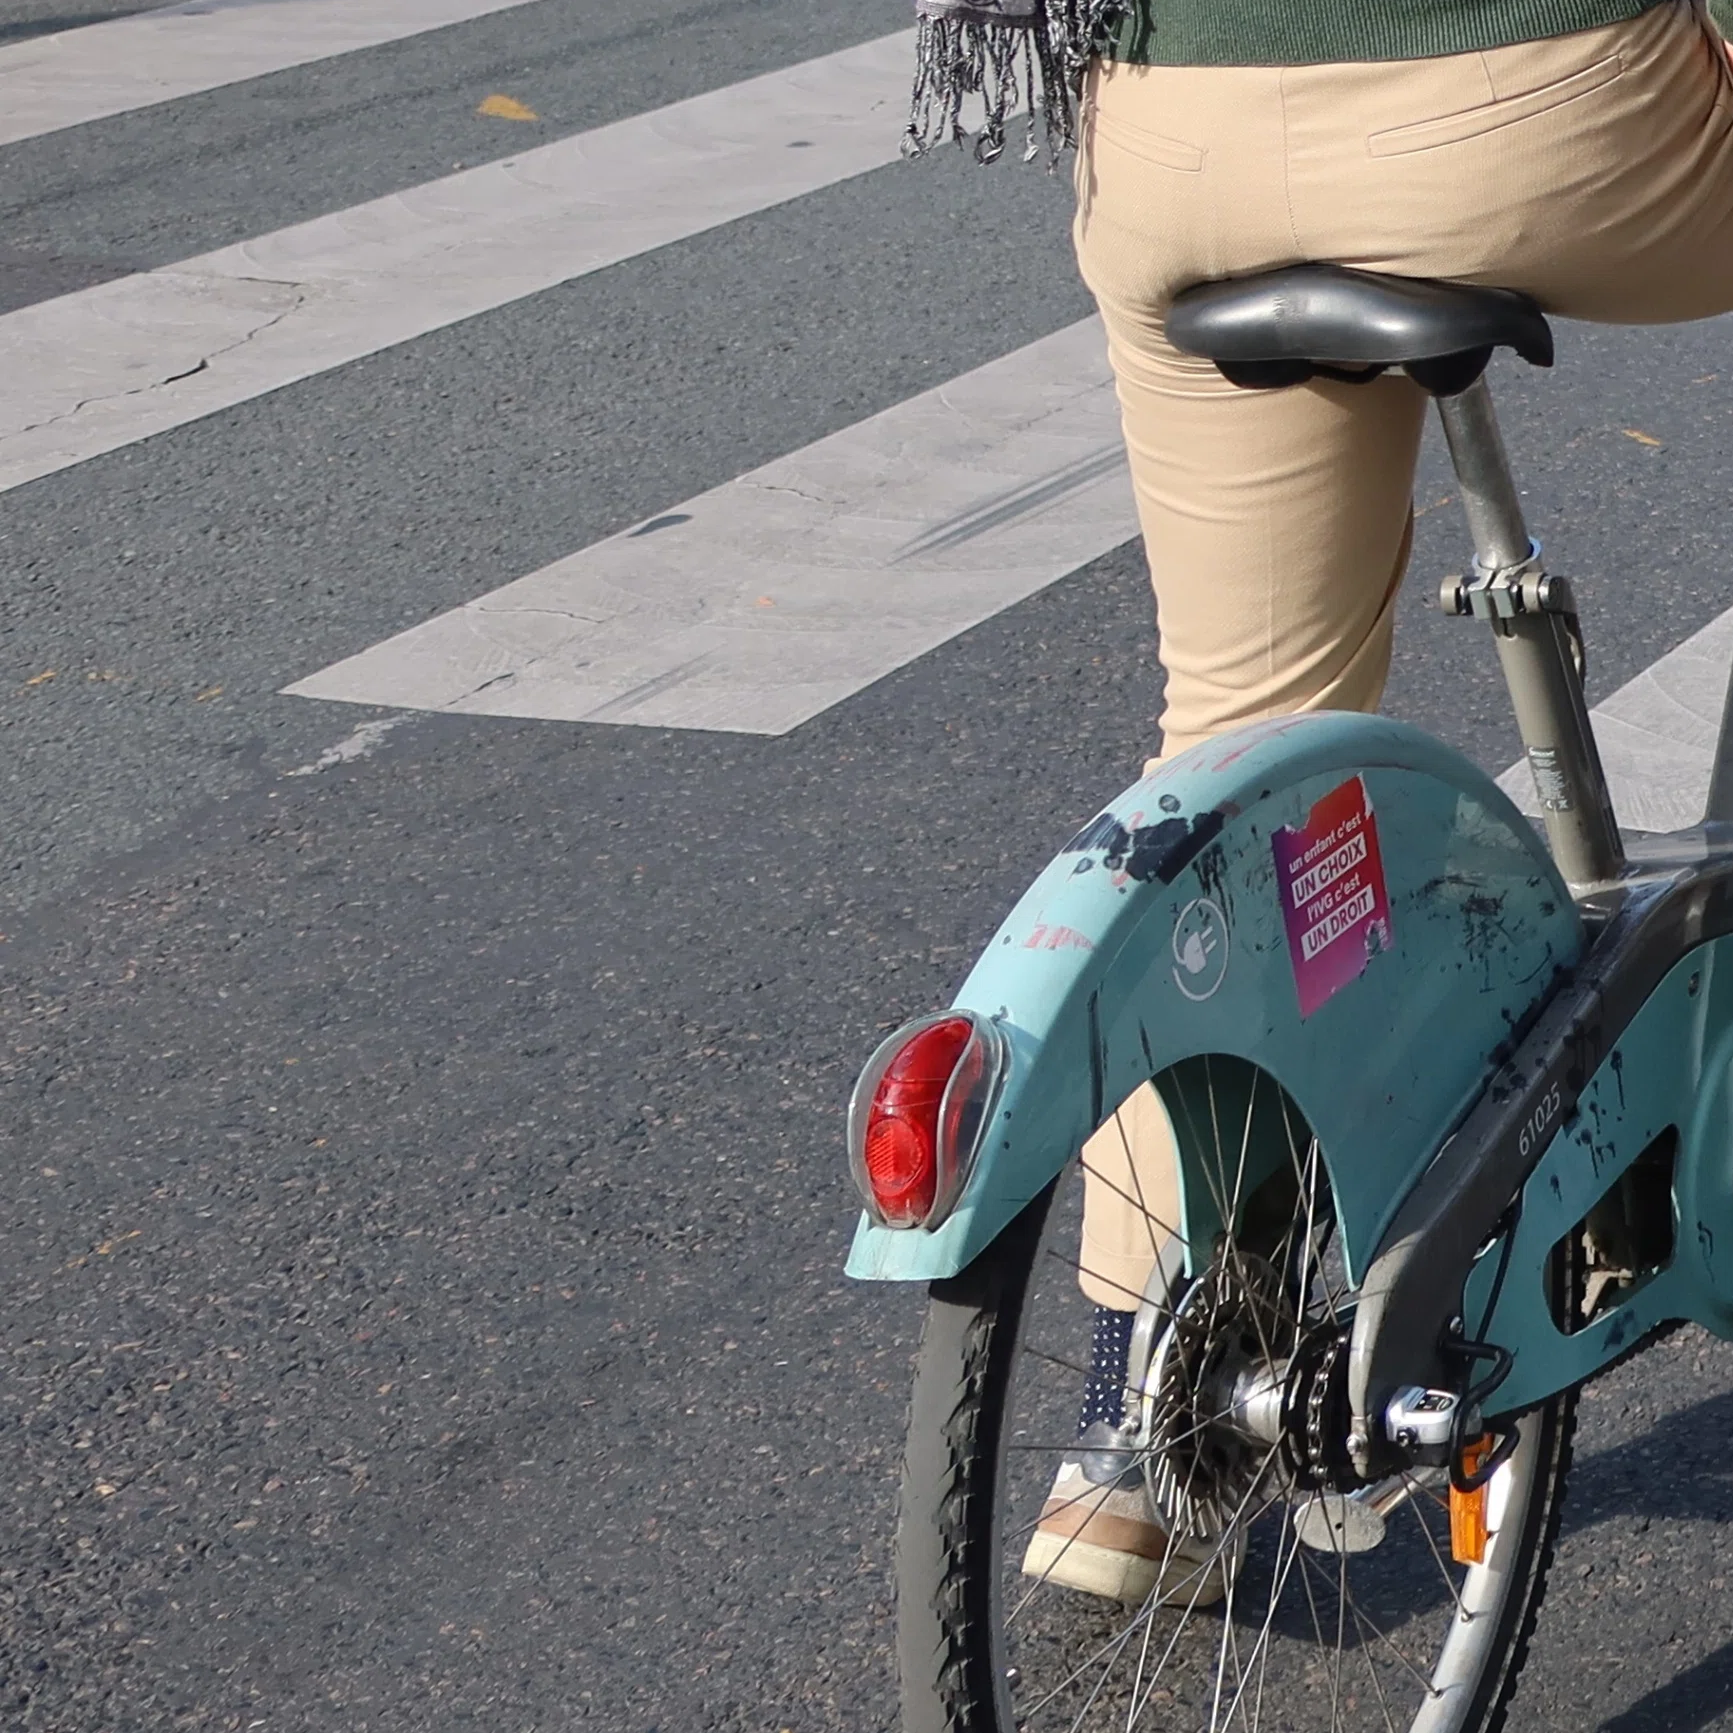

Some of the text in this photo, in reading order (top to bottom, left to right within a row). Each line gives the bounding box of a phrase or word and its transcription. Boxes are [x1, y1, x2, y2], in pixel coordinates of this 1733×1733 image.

[1289, 812, 1362, 874] un enfant c'est
[1295, 839, 1364, 901] UN CHOIX
[1307, 873, 1361, 922] l'IVG c'est
[1307, 927, 1329, 953] UN
[1331, 892, 1369, 934] DROIT
[1519, 1081, 1561, 1156] 61025
